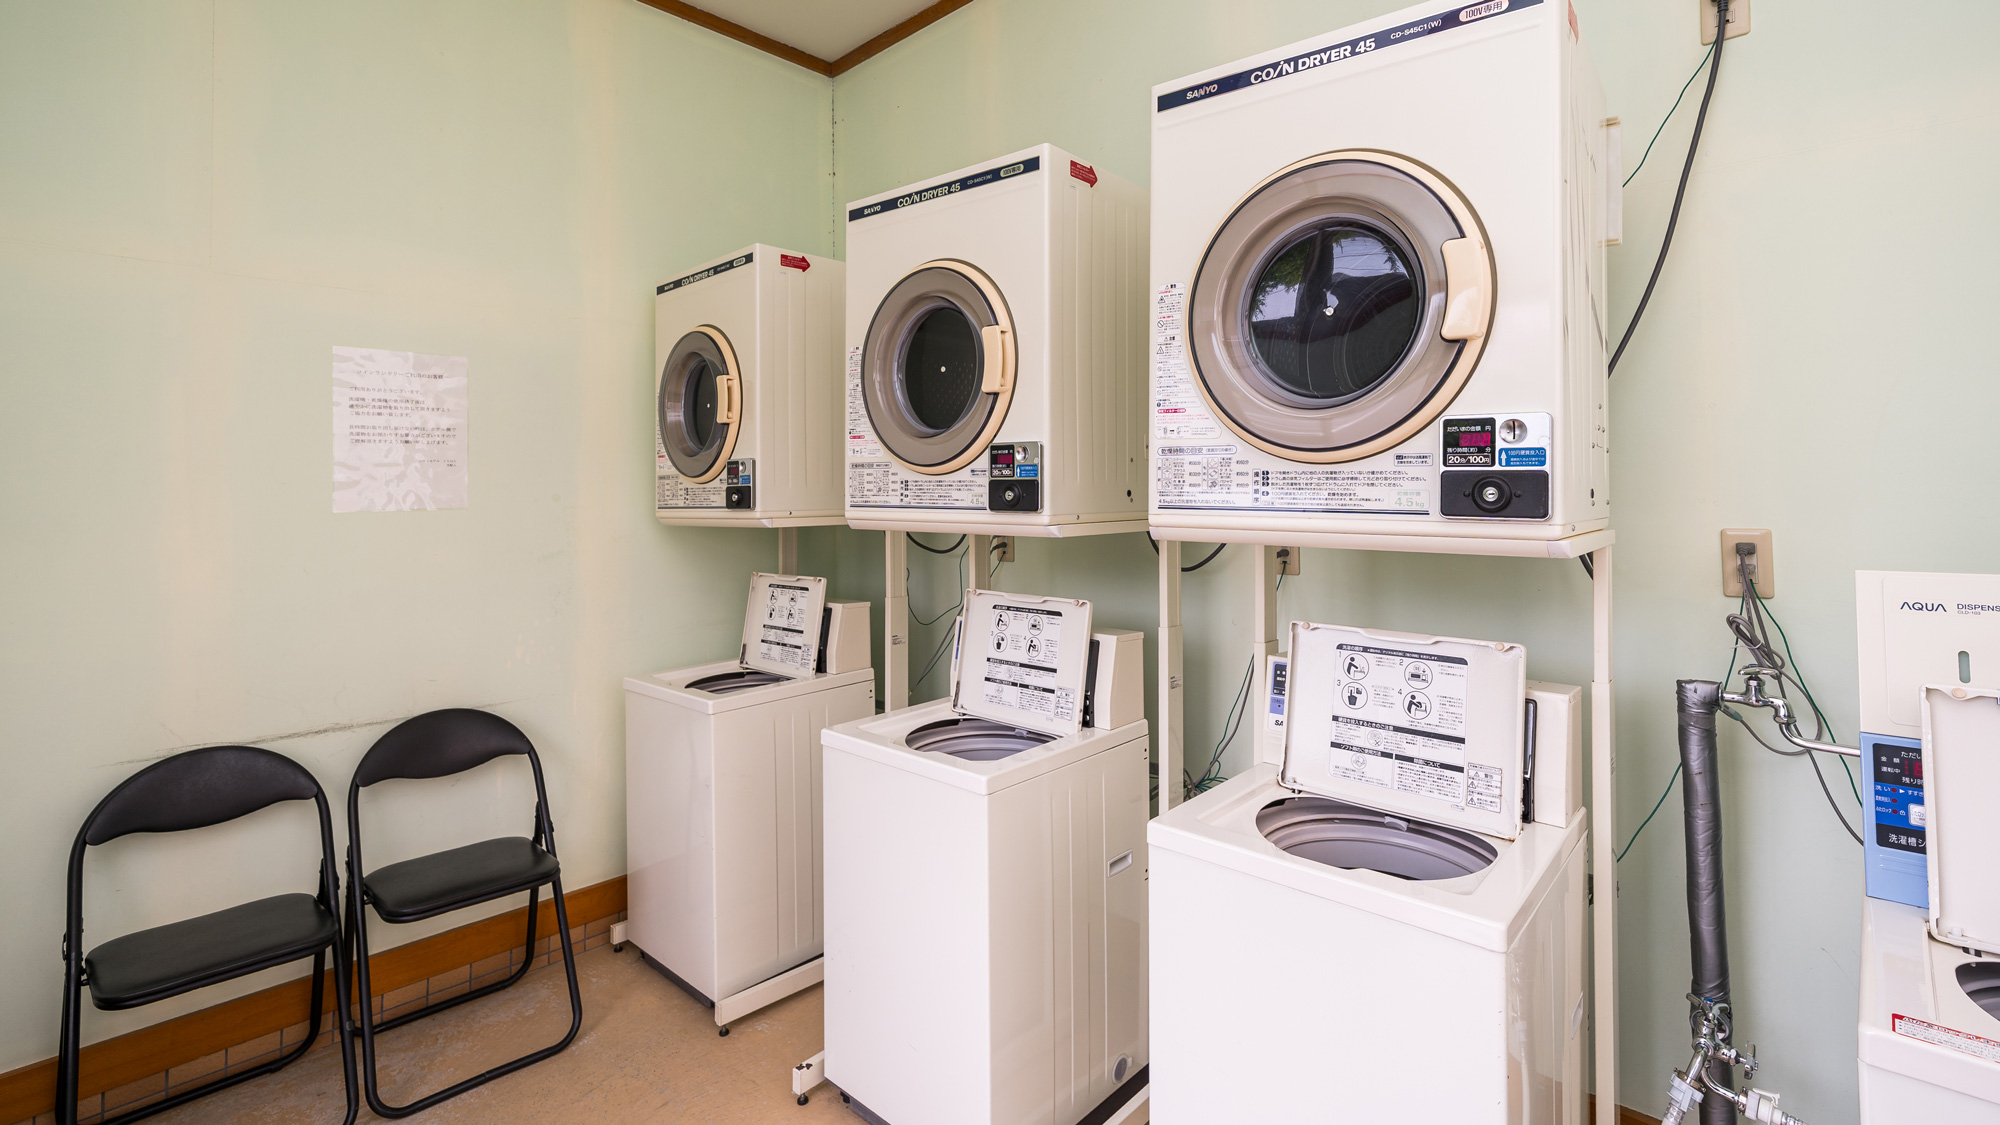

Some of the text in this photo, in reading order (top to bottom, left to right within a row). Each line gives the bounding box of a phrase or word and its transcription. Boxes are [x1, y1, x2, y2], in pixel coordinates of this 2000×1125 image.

[1186, 84, 1218, 100] SANYO
[1298, 45, 1352, 71] DRYER
[1356, 37, 1376, 54] 45
[1390, 18, 1442, 40] CD-S45C1(W)
[864, 205, 881, 214] SANYO
[922, 186, 948, 201] DRYER
[950, 182, 960, 193] 45
[1448, 456, 1490, 464] 20分/100円
[1395, 498, 1413, 507] 4.5
[1900, 601, 1947, 613] AQUA
